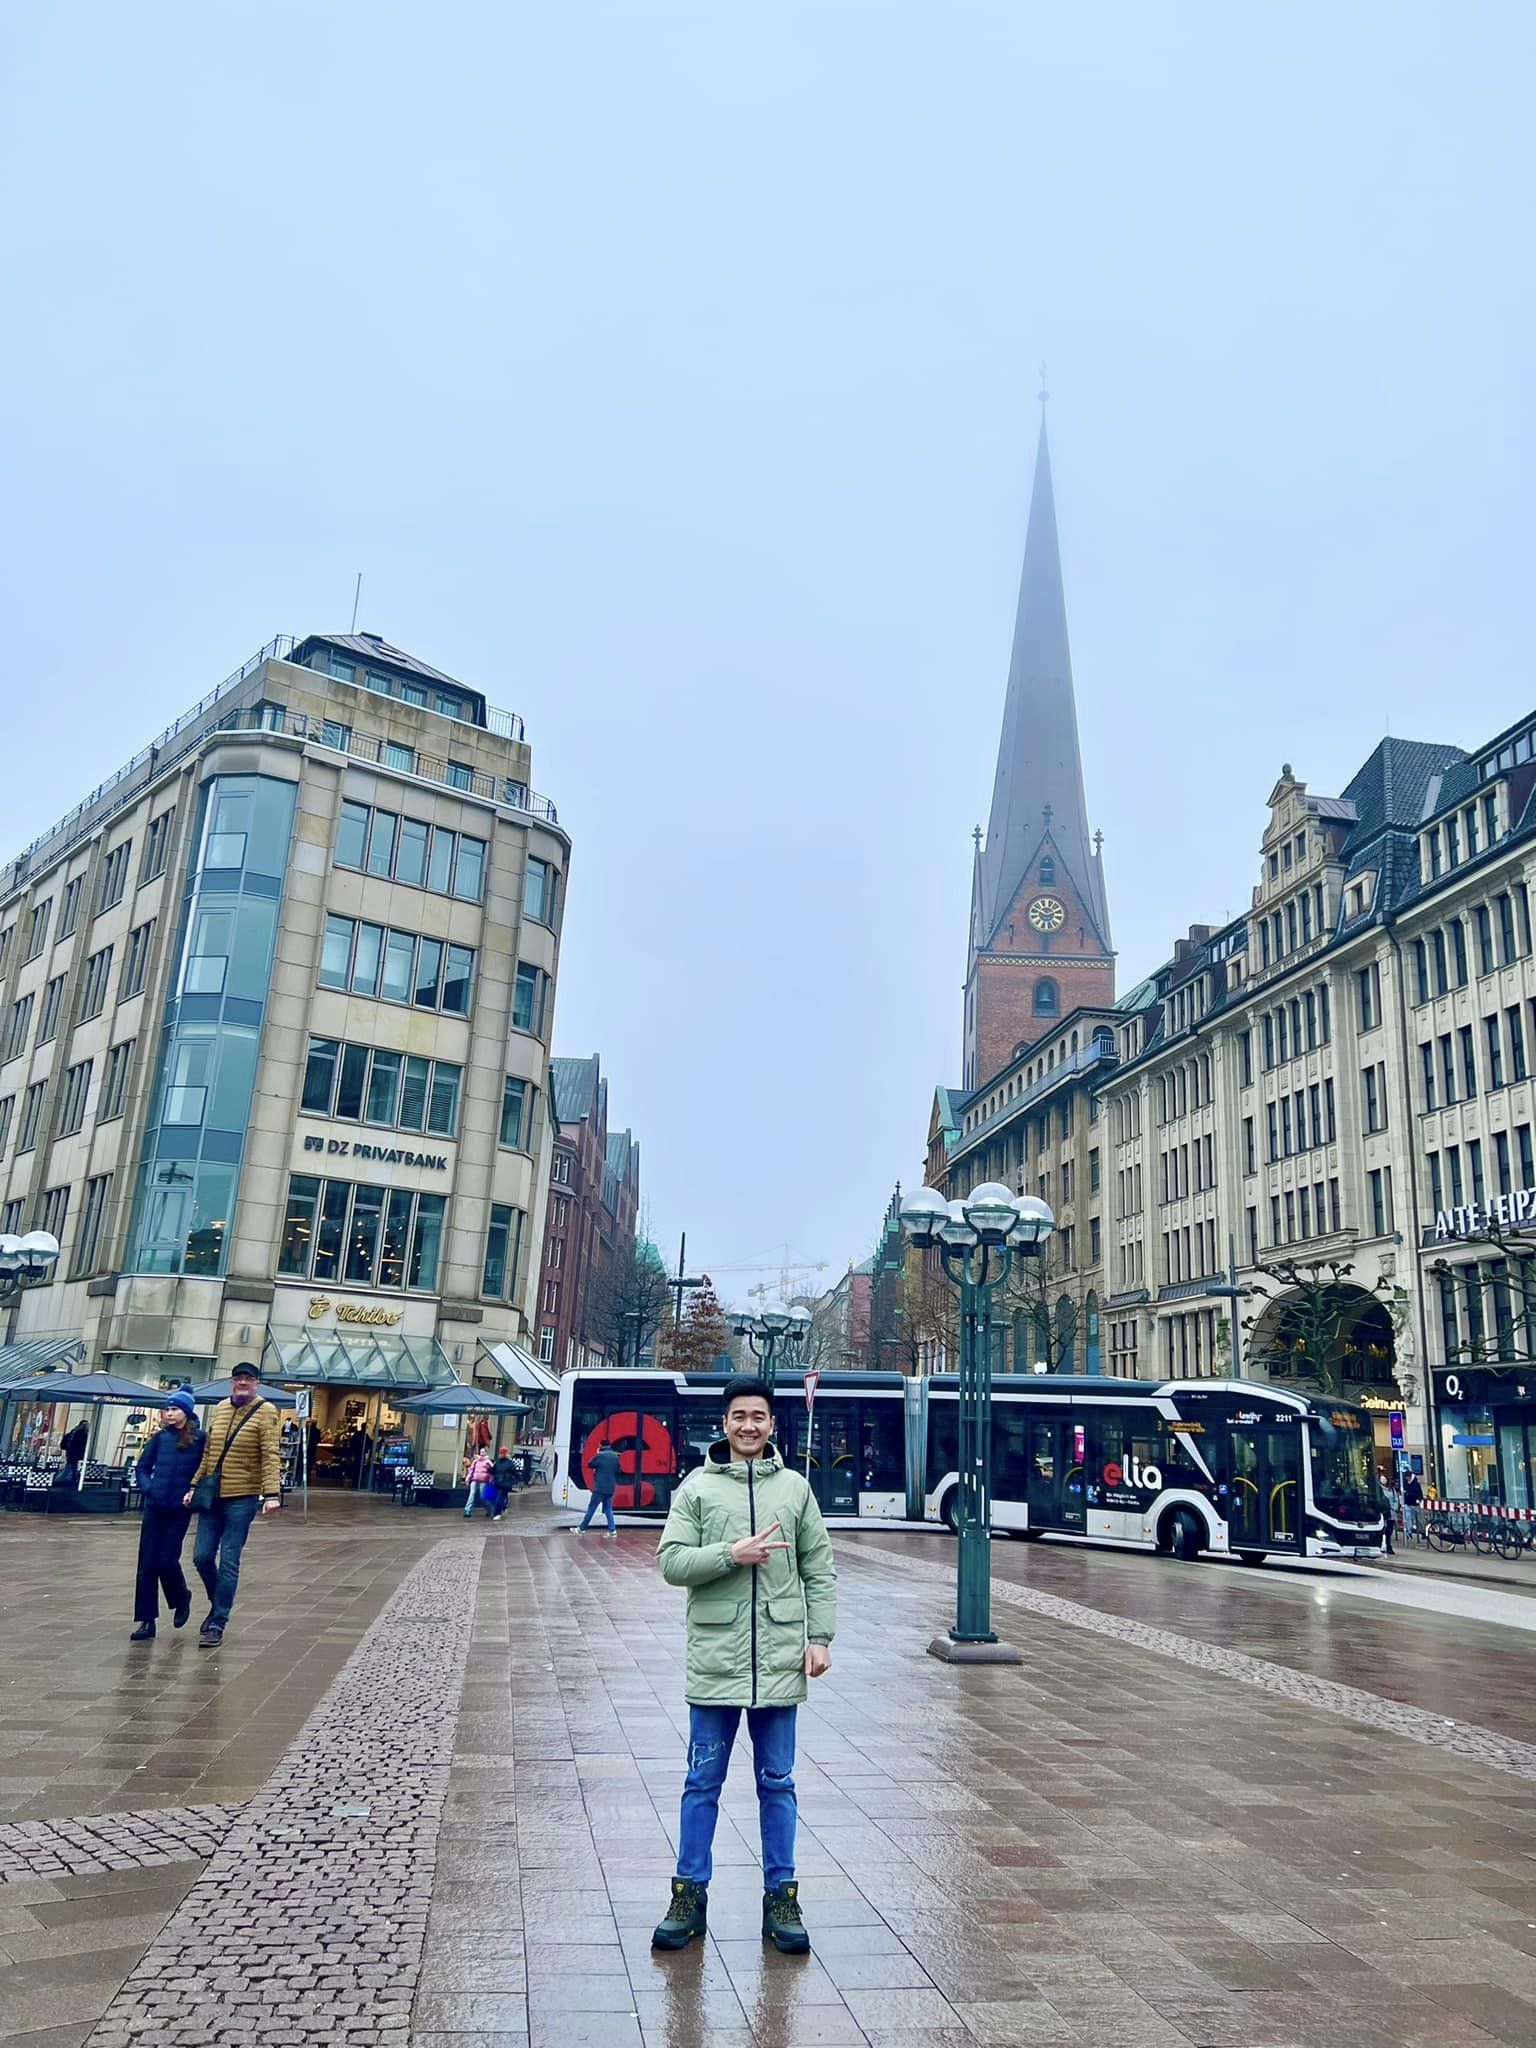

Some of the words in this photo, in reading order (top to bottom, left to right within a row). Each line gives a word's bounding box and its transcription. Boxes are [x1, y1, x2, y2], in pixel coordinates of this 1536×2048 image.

[327, 1139, 350, 1155] DZ
[352, 1143, 448, 1170] PRIVATBANK
[336, 1304, 404, 1326] Tchibo
[1275, 1413, 1292, 1423] 2211
[1103, 1454, 1162, 1490] elia
